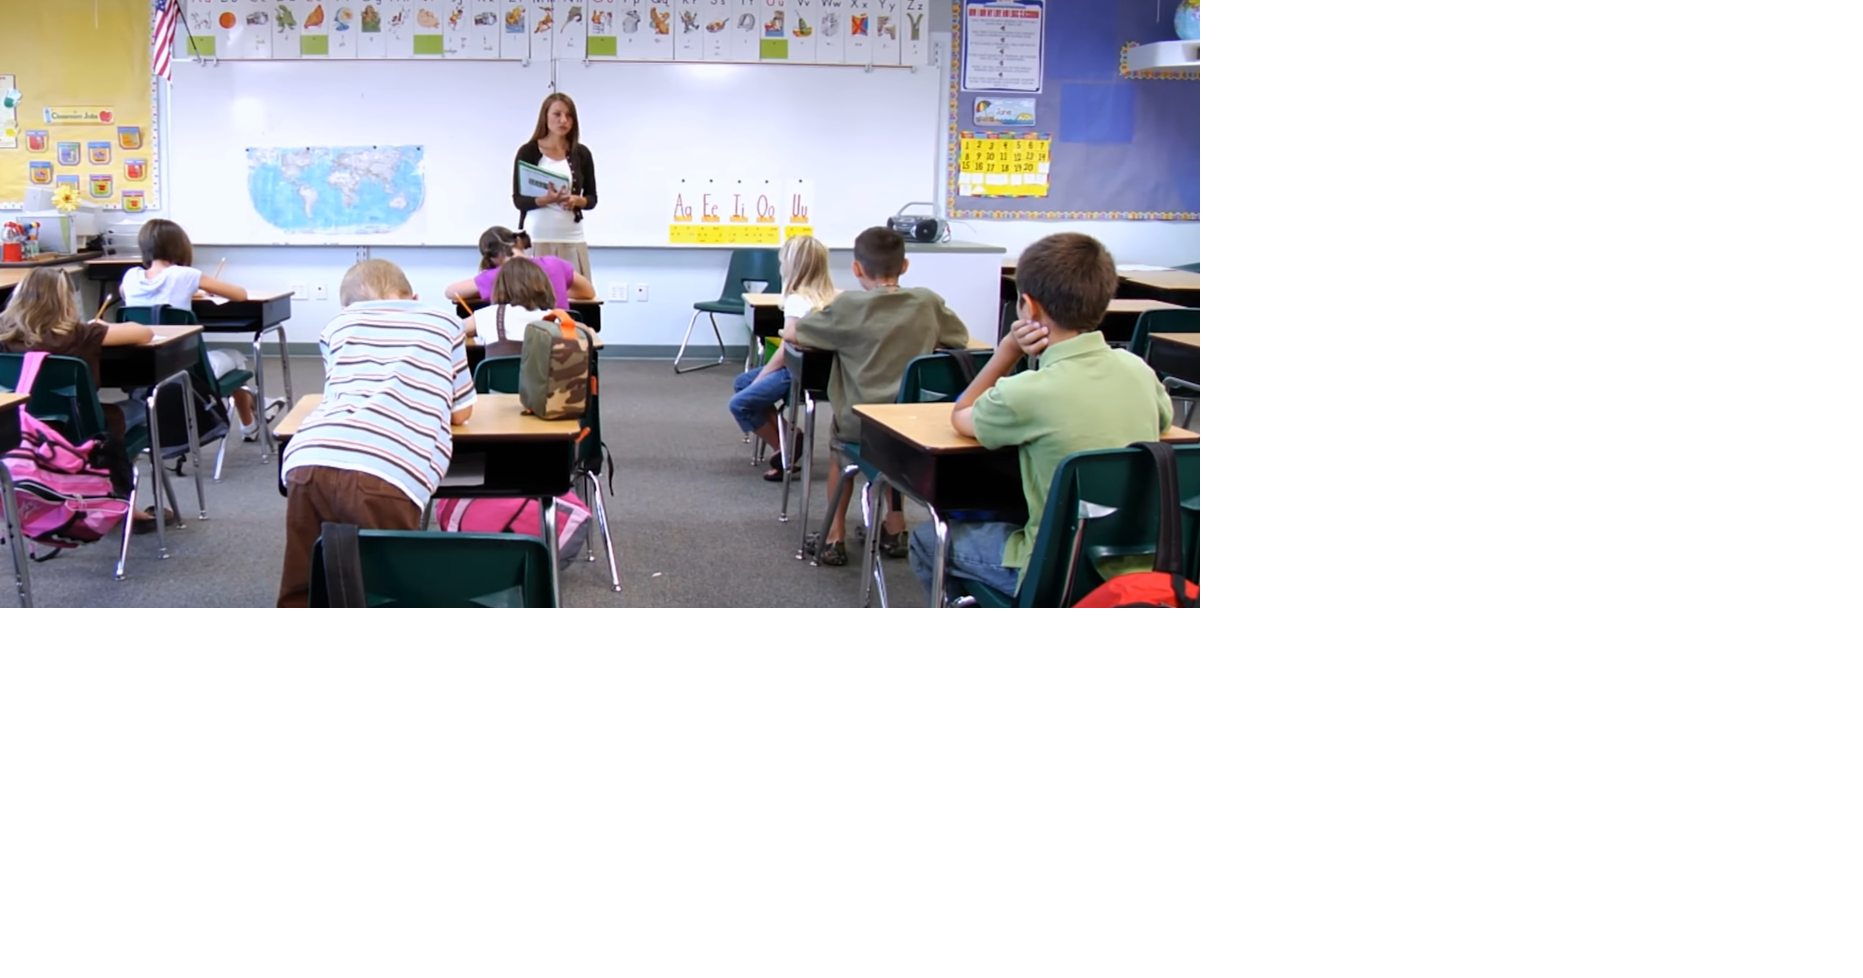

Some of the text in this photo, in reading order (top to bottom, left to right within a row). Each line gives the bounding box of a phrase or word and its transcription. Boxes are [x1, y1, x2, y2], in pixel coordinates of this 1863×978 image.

[986, 152, 995, 160] 10
[1000, 152, 1007, 161] 11
[1014, 153, 1021, 162] 12
[1026, 152, 1034, 160] 13
[1038, 153, 1046, 161] 14
[962, 161, 970, 169] 15
[975, 162, 983, 170] 16
[986, 163, 995, 171] 17
[1001, 164, 1009, 172] 18
[1014, 164, 1022, 172] 19
[673, 193, 808, 217] Aa Ee Ii Oo Uu
